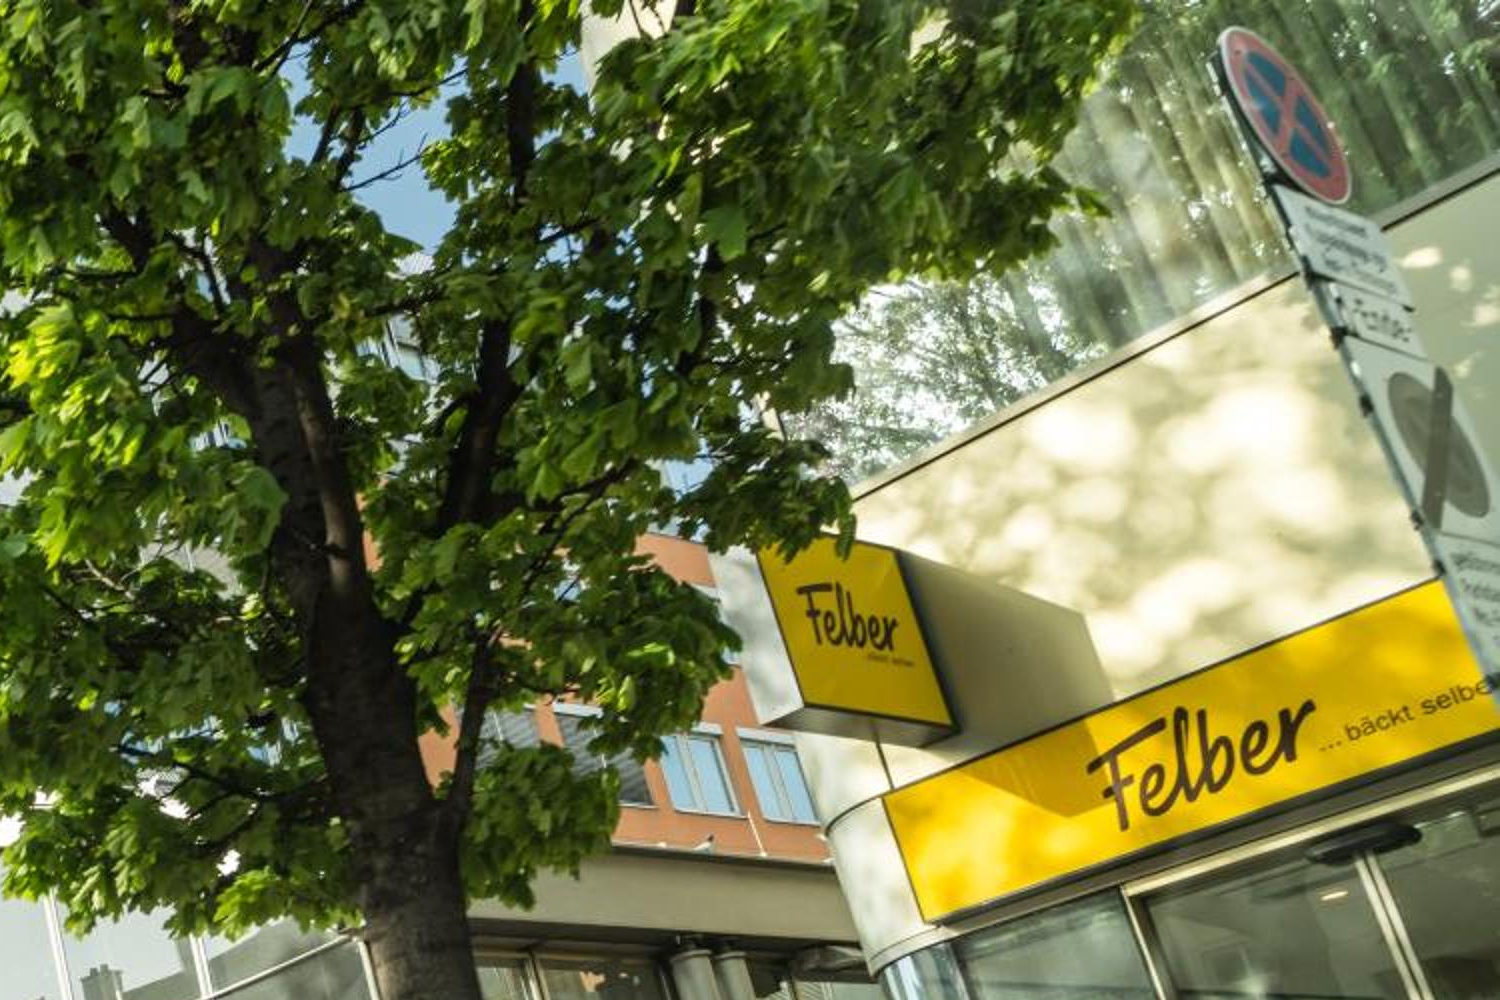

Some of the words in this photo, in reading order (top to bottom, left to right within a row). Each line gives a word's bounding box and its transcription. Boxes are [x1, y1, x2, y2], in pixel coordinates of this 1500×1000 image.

[796, 582, 899, 651] Felber
[1420, 677, 1493, 716] selbe
[1086, 699, 1317, 832] Felber
